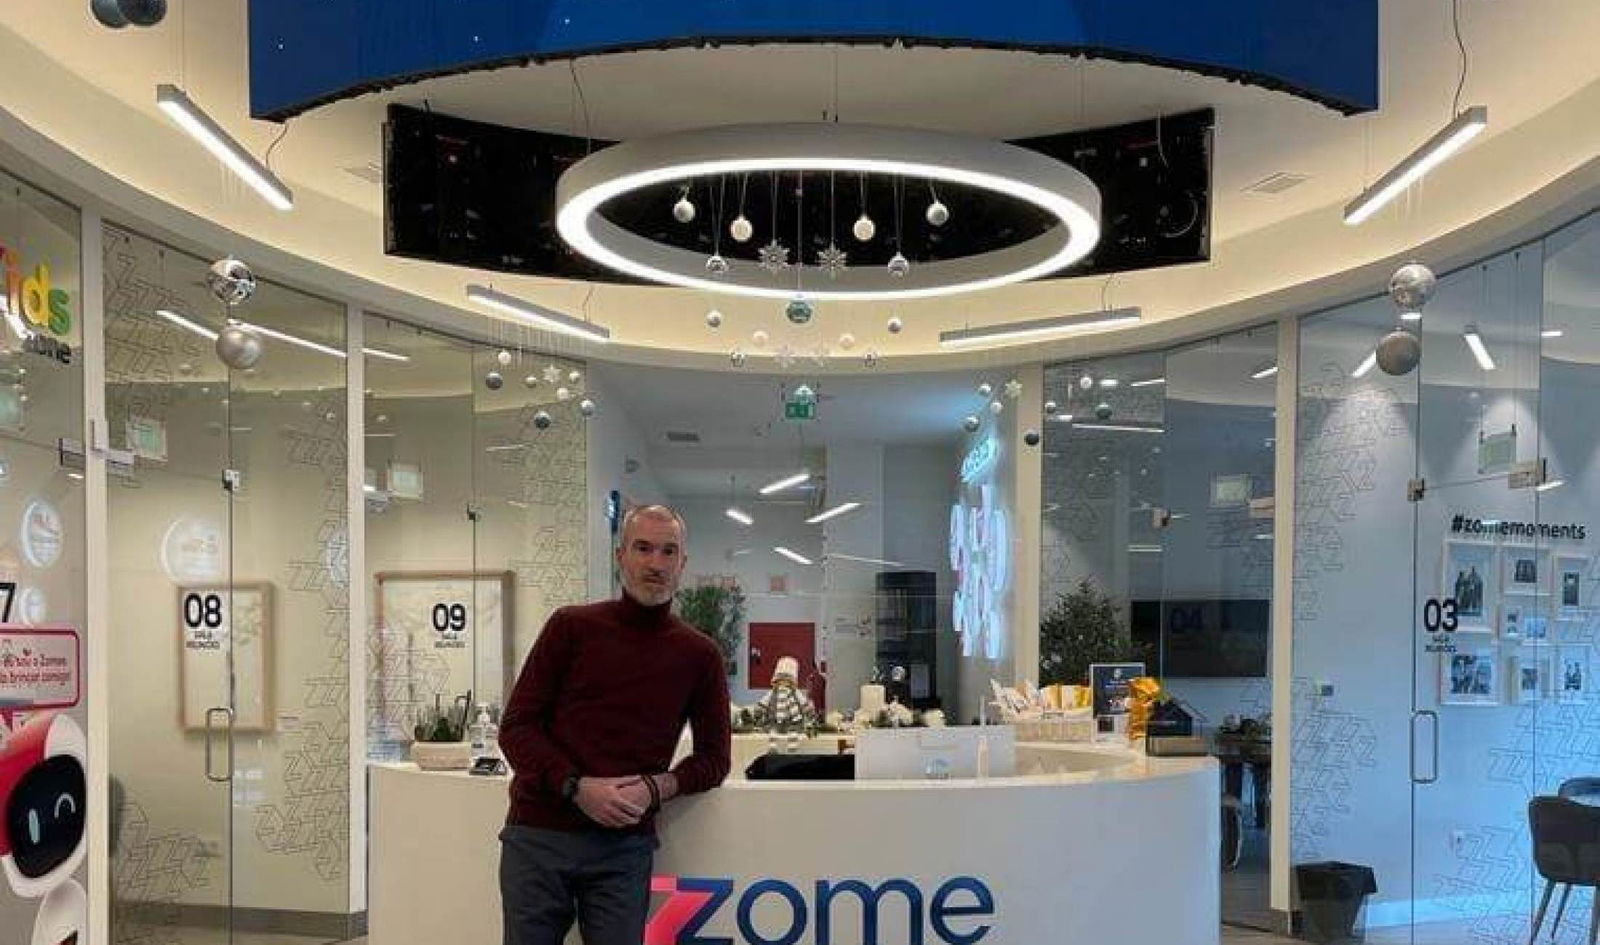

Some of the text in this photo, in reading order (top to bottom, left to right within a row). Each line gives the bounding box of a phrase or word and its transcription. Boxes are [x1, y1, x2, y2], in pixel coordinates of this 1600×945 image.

[0, 246, 71, 336] ids
[184, 593, 222, 628] 08
[433, 603, 466, 632] 09
[1424, 599, 1458, 632] 03
[677, 876, 995, 945] zome
